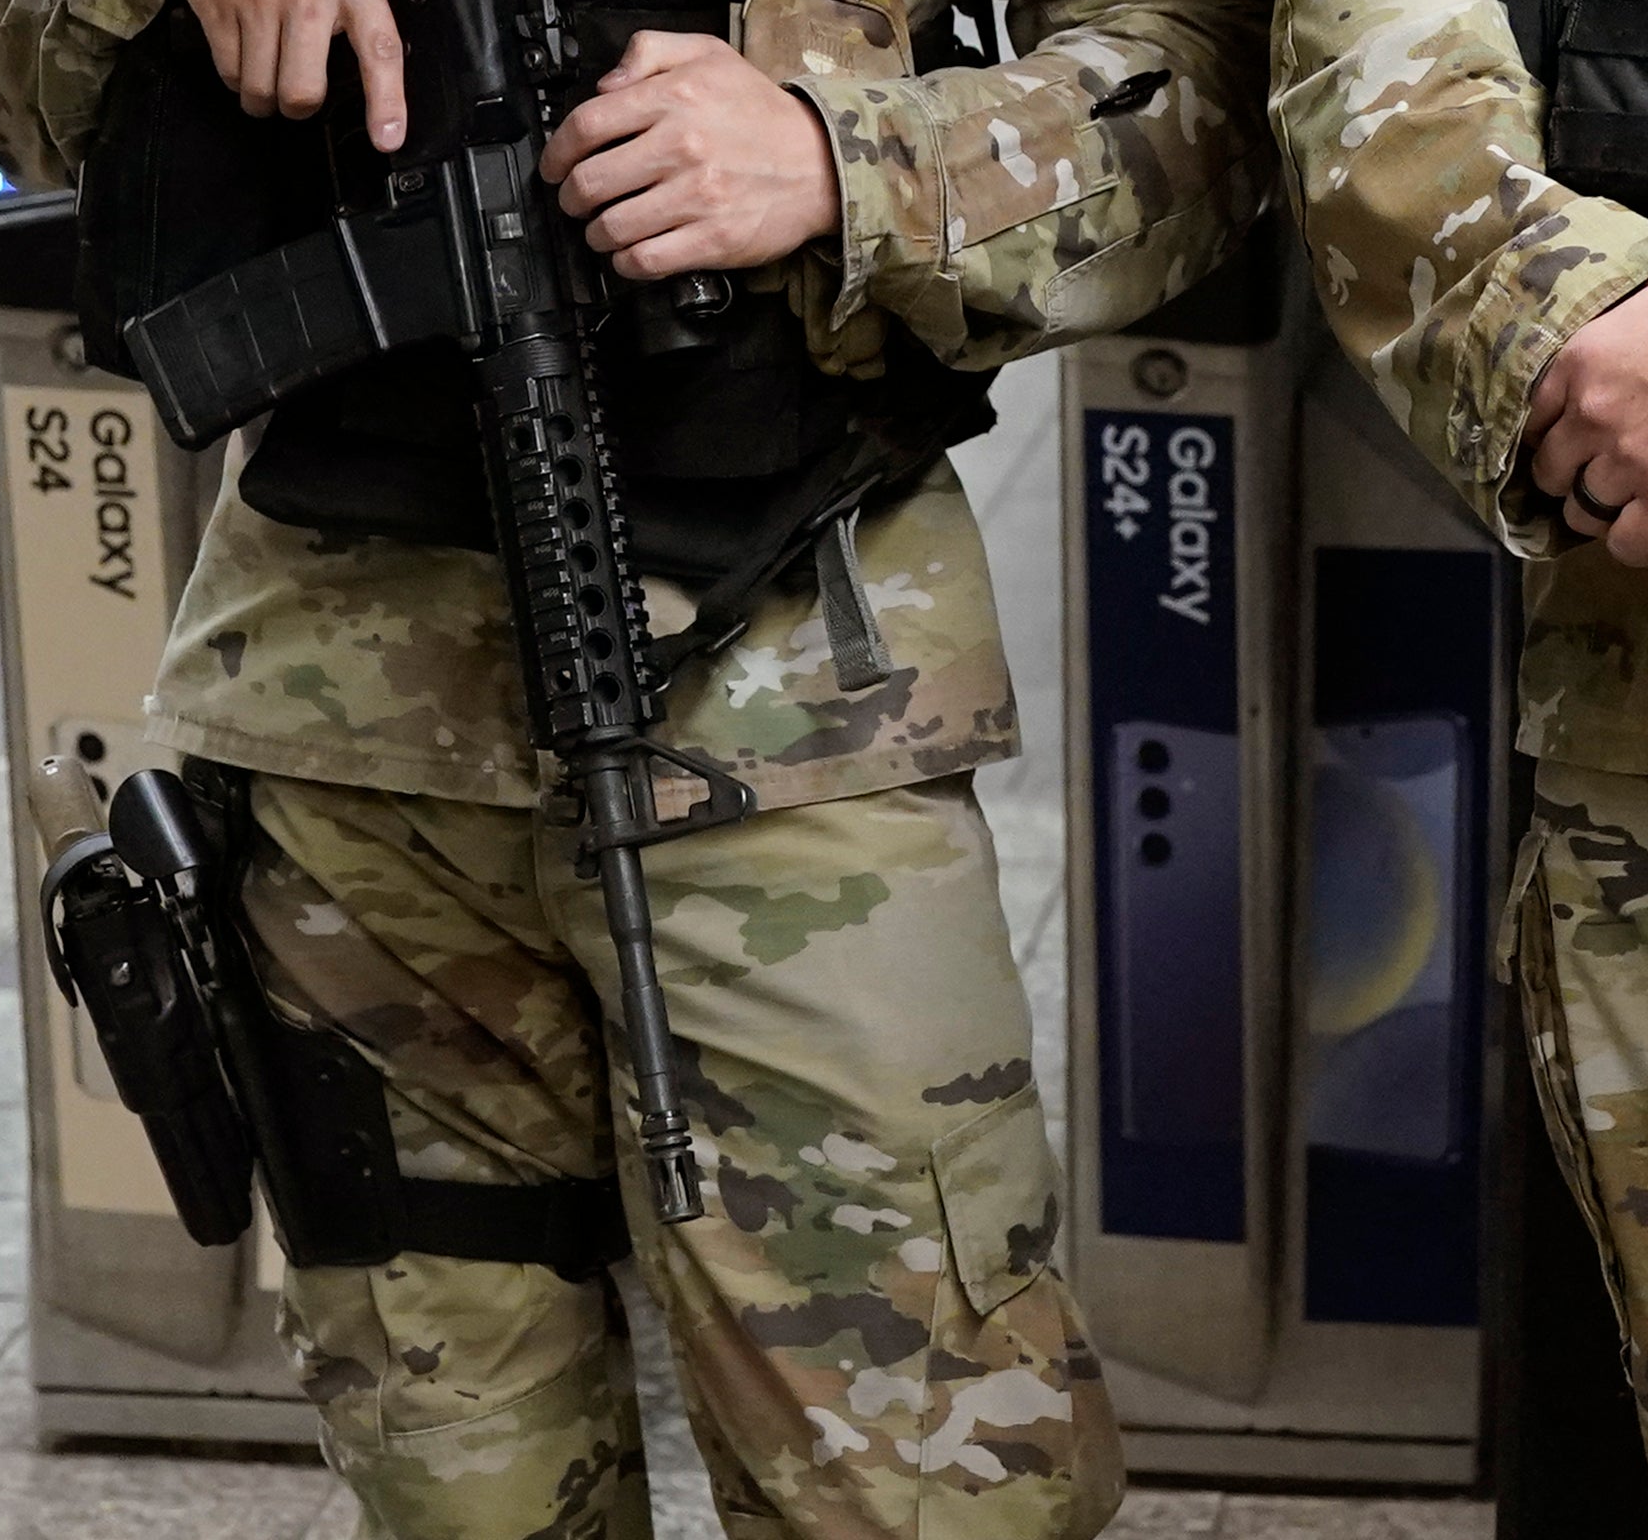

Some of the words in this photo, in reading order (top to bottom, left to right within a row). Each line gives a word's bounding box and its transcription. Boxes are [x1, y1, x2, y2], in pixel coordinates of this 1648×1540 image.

[26, 404, 72, 497] S24
[88, 410, 137, 601] Galaxy
[1101, 423, 1151, 541] S24+
[1157, 426, 1218, 626] Galaxy
